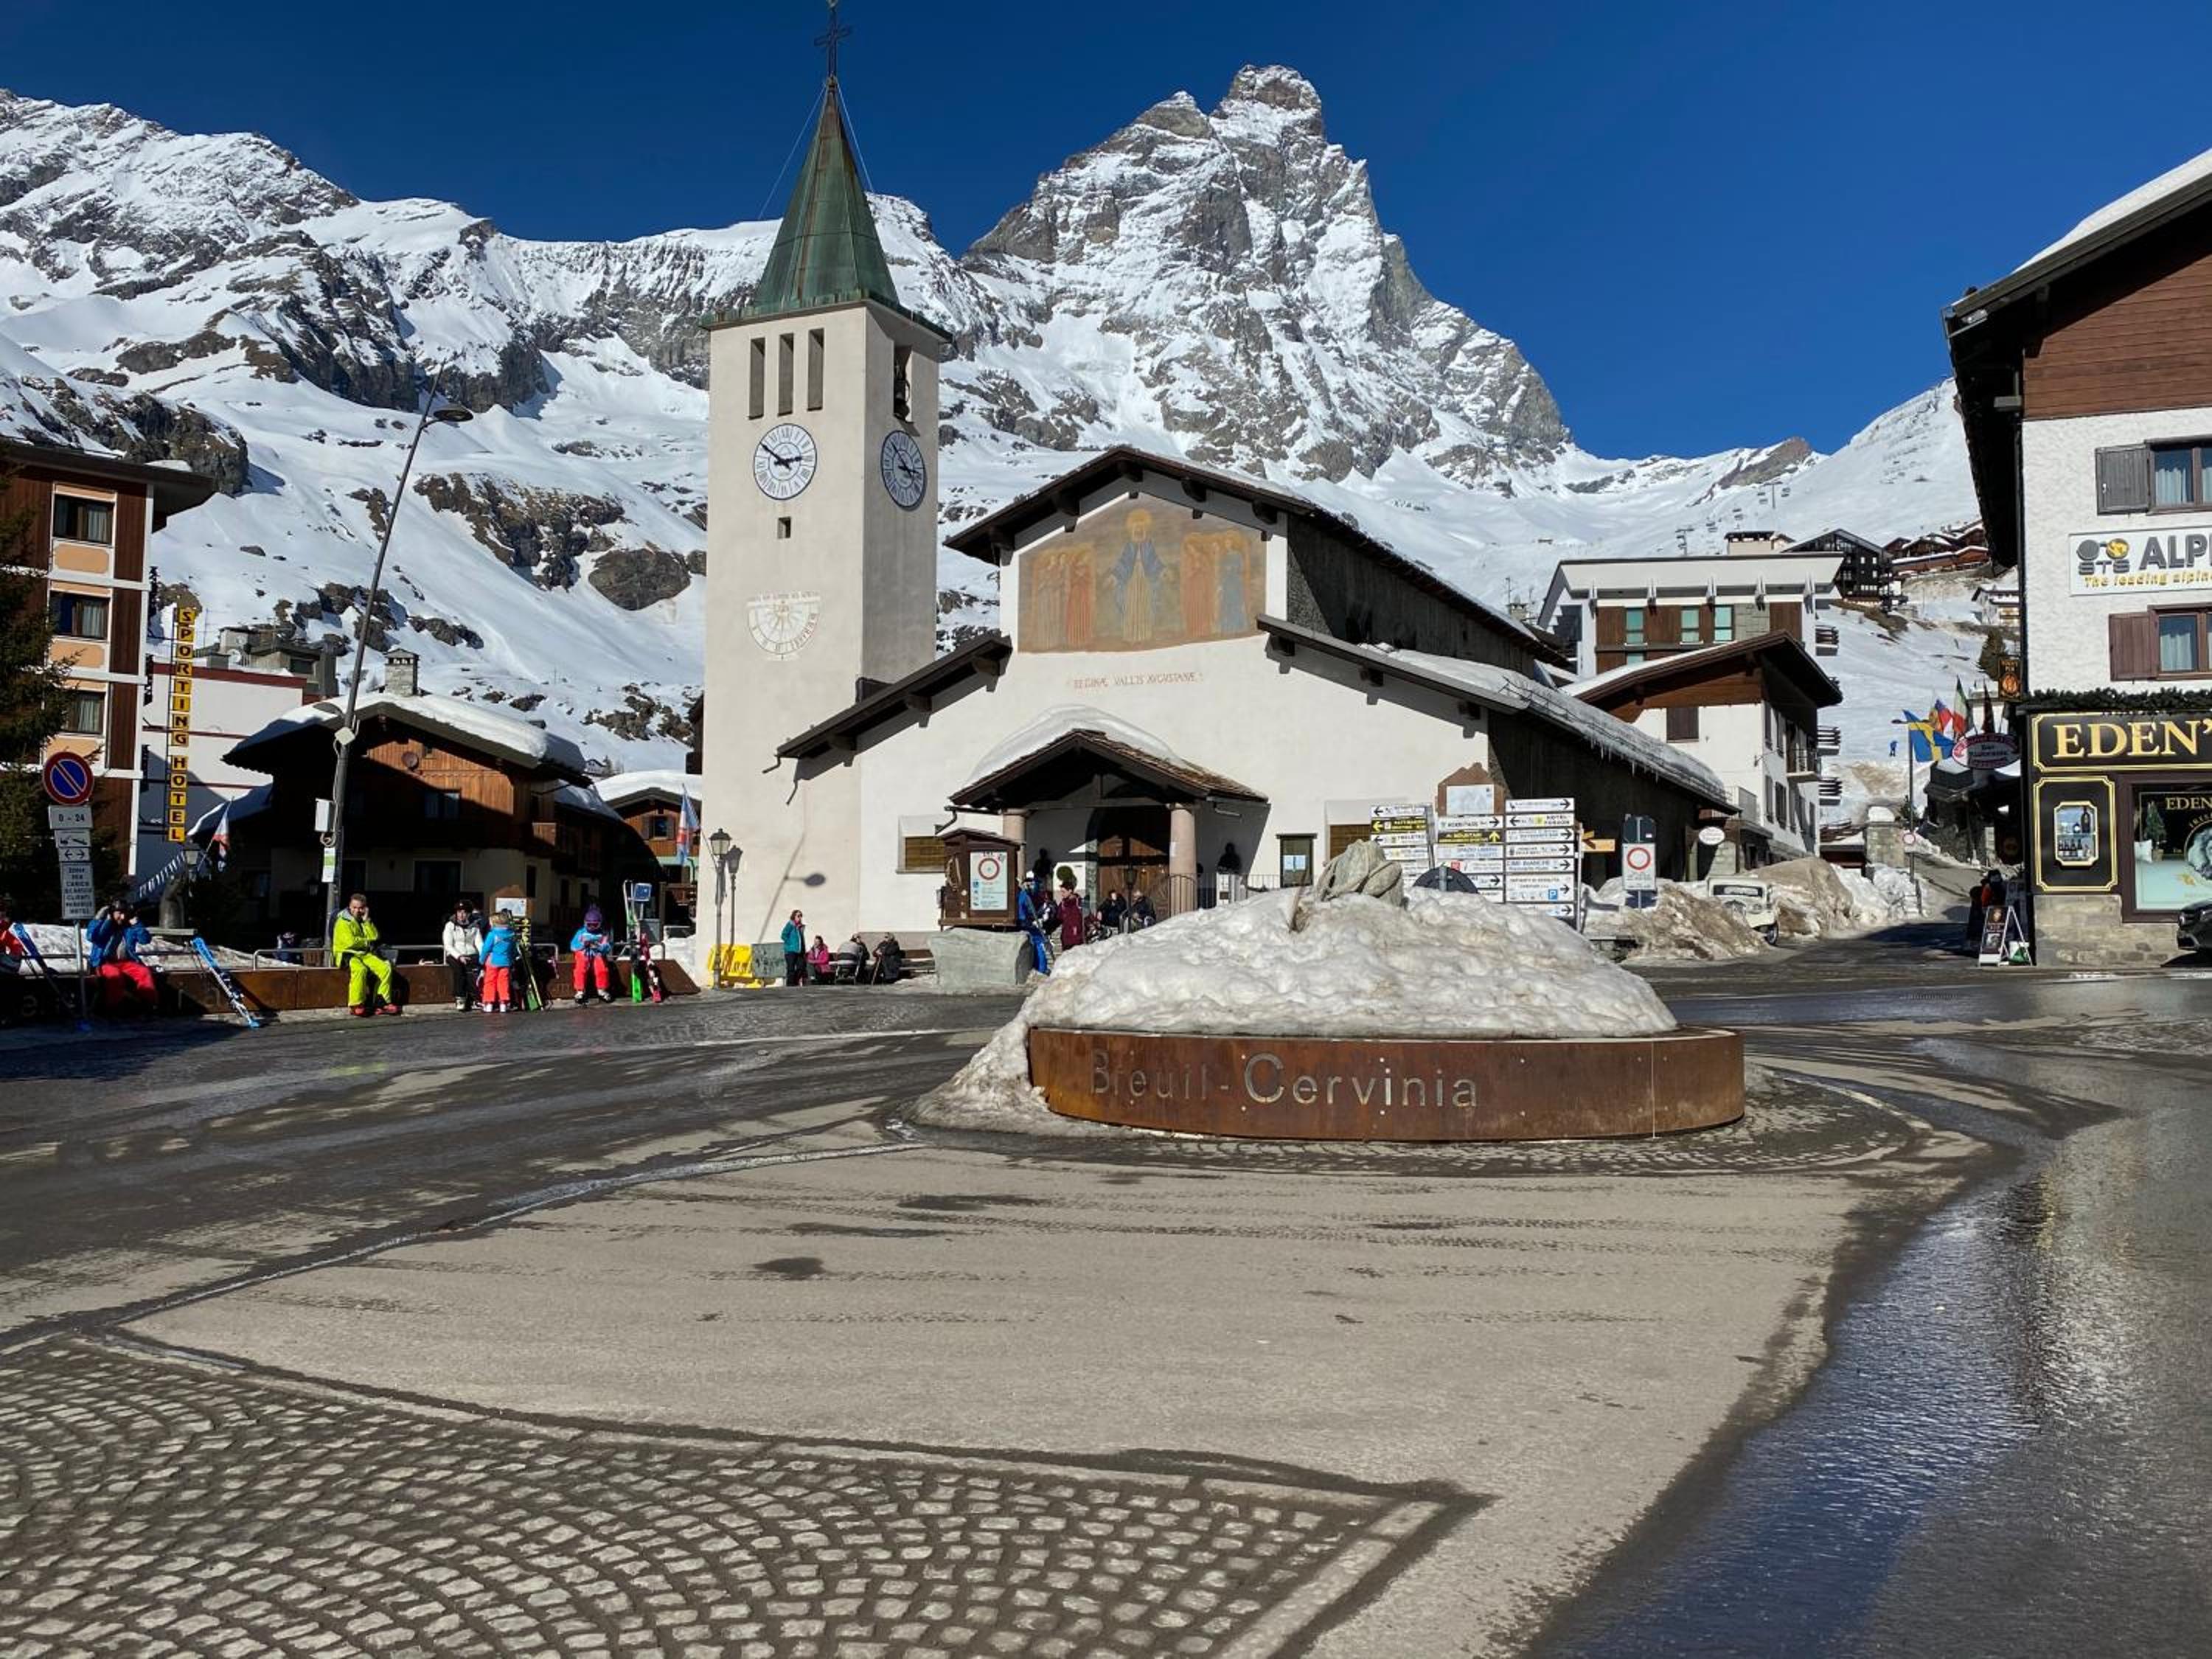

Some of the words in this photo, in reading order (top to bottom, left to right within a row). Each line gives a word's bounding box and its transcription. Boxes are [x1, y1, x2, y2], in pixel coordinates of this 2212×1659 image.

[2084, 577, 2109, 588] The
[2114, 572, 2168, 585] leading
[2173, 570, 2212, 584] alpin
[174, 611, 192, 744] SPORTING
[75, 813, 85, 822] 24
[171, 757, 186, 840] HOTEL
